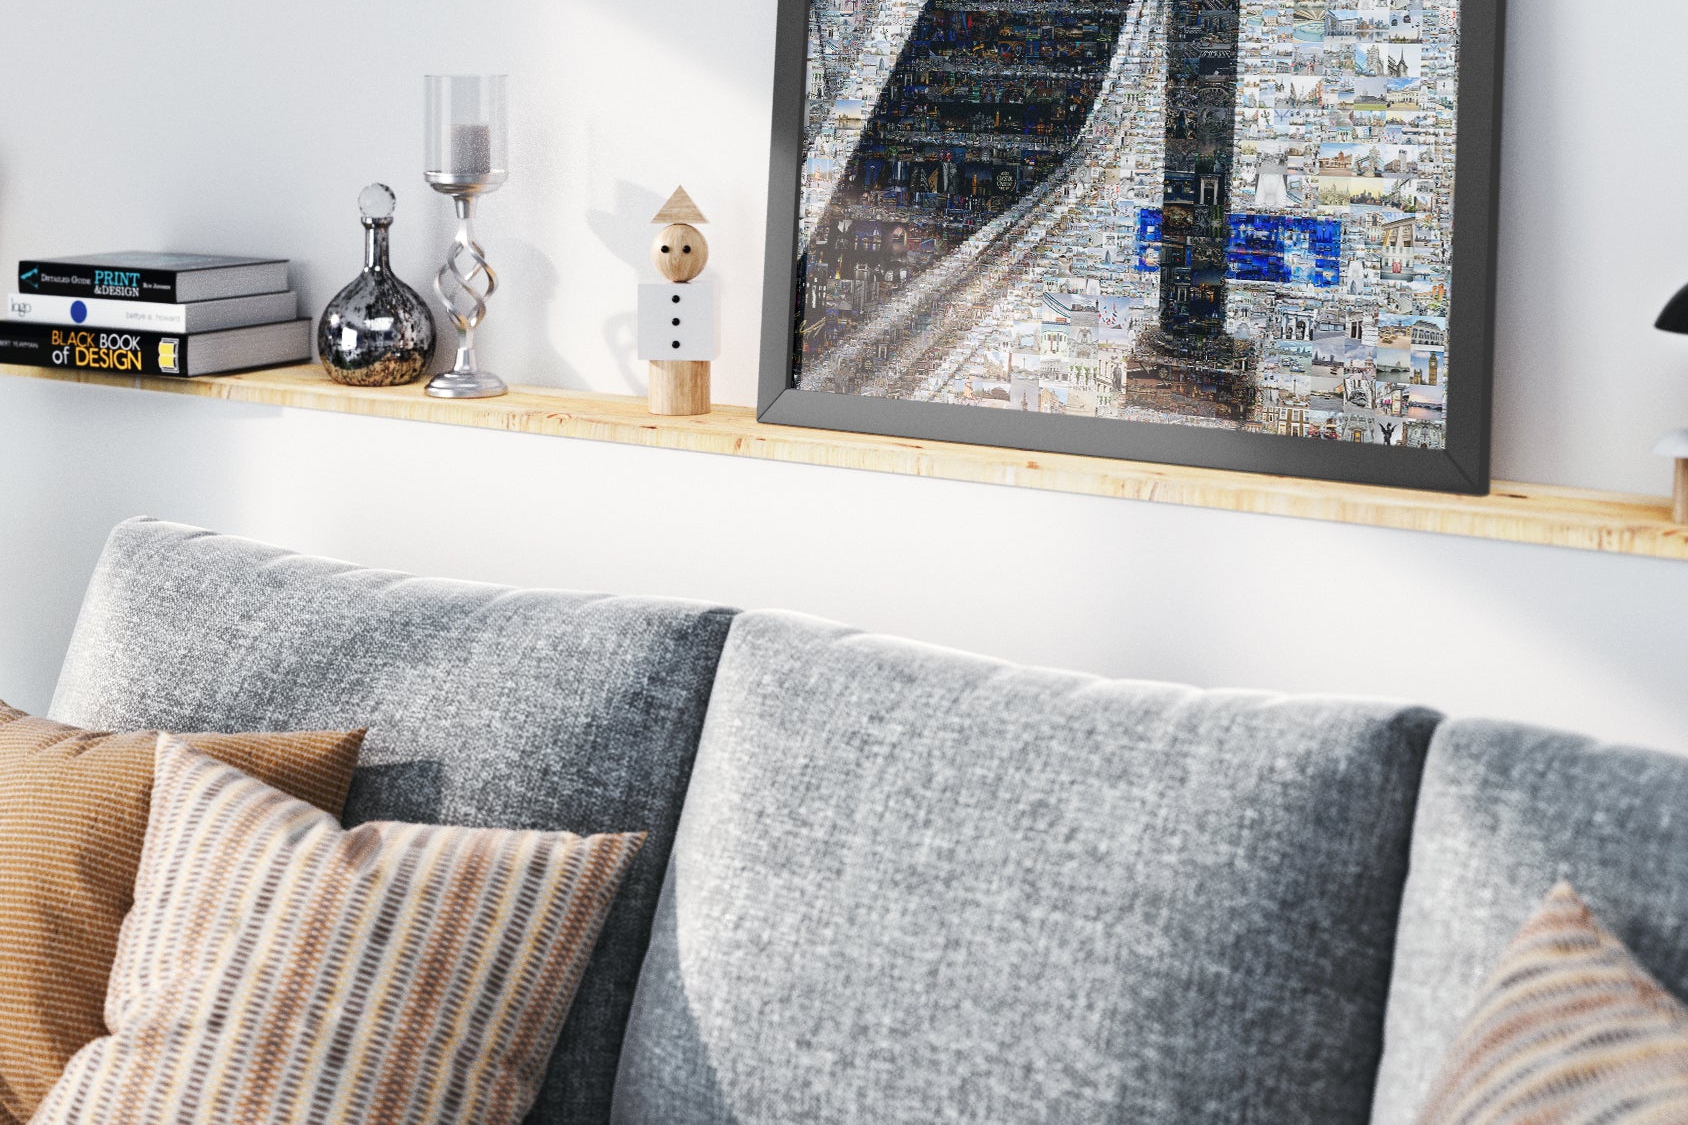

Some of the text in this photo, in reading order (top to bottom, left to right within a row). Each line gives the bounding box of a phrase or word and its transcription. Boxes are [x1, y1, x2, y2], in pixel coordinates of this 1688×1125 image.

[94, 269, 140, 287] PRINT
[94, 285, 140, 297] &DESIGN
[51, 330, 141, 351] BLACK BOOK
[52, 346, 142, 371] of DESIGN
